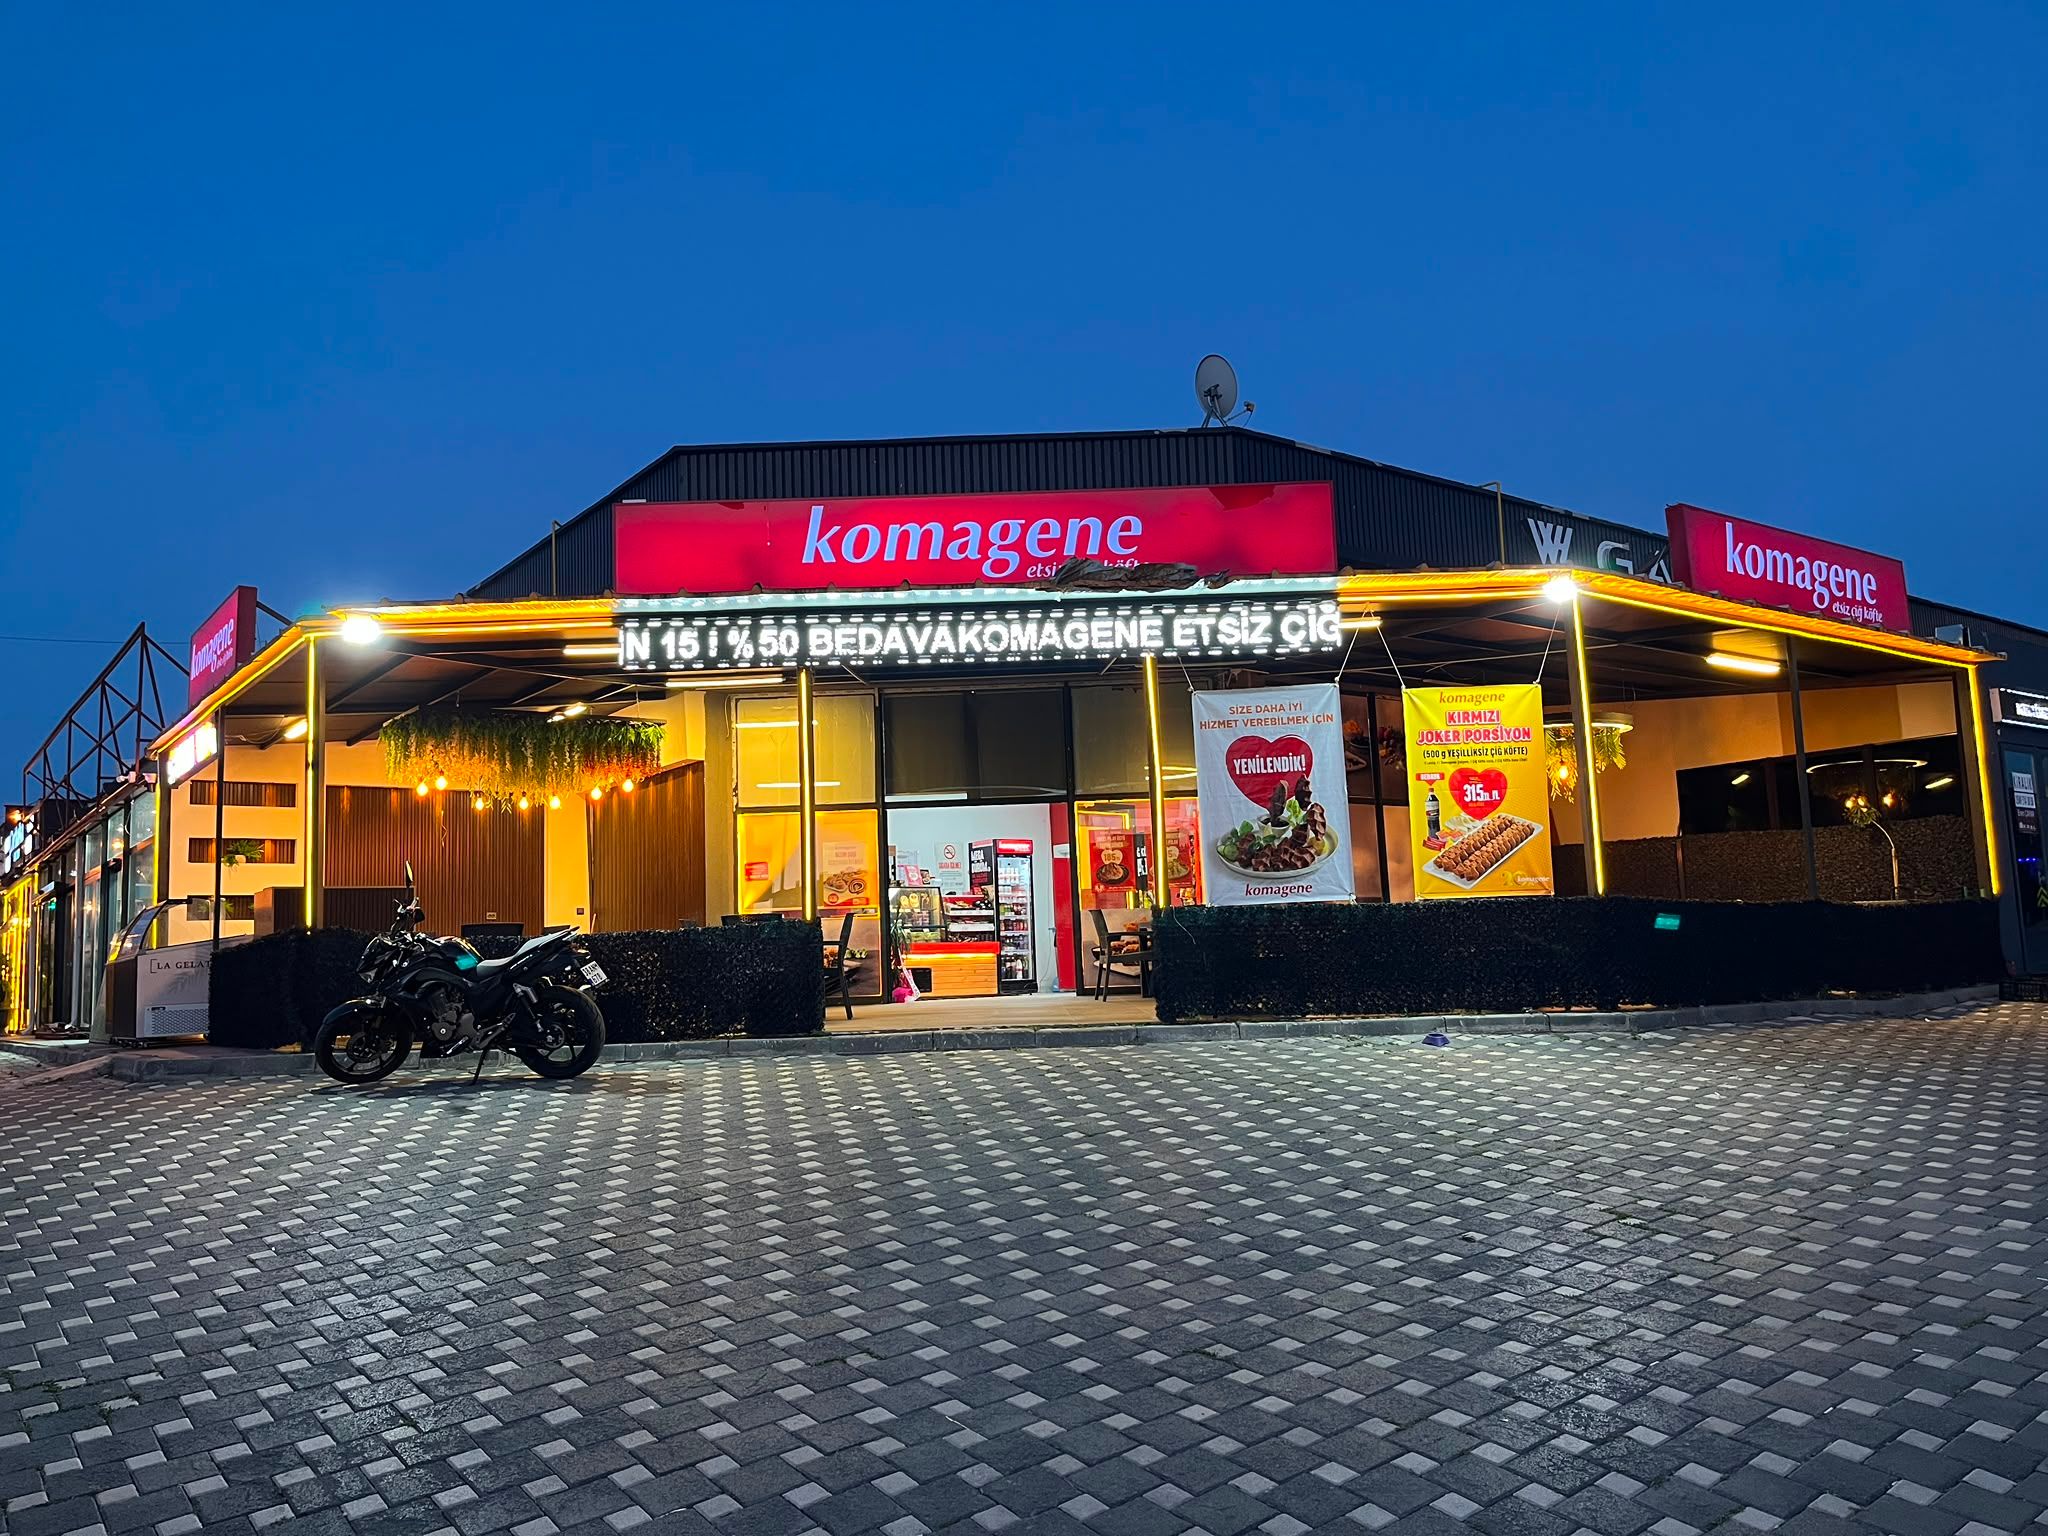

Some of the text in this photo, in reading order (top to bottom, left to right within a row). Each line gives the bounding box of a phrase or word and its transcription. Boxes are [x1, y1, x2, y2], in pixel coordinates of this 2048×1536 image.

[802, 505, 1143, 578] komagene
[1026, 561, 1061, 578] etsi
[1725, 521, 1877, 609] komagene
[1863, 607, 1883, 623] köfte
[661, 628, 700, 659] 15
[1439, 691, 1506, 706] komagene
[1229, 705, 1253, 715] SİZE
[1255, 704, 1286, 714] DAHA
[1446, 709, 1500, 725] KIRMIZI
[1200, 713, 1334, 730] HİZMET VEREBİLMEK İÇİN
[1417, 725, 1532, 745] JOKER PORSİYON
[1233, 752, 1306, 775] YENİLENDİK!
[1245, 882, 1313, 898] komagene
[156, 961, 171, 970] LA
